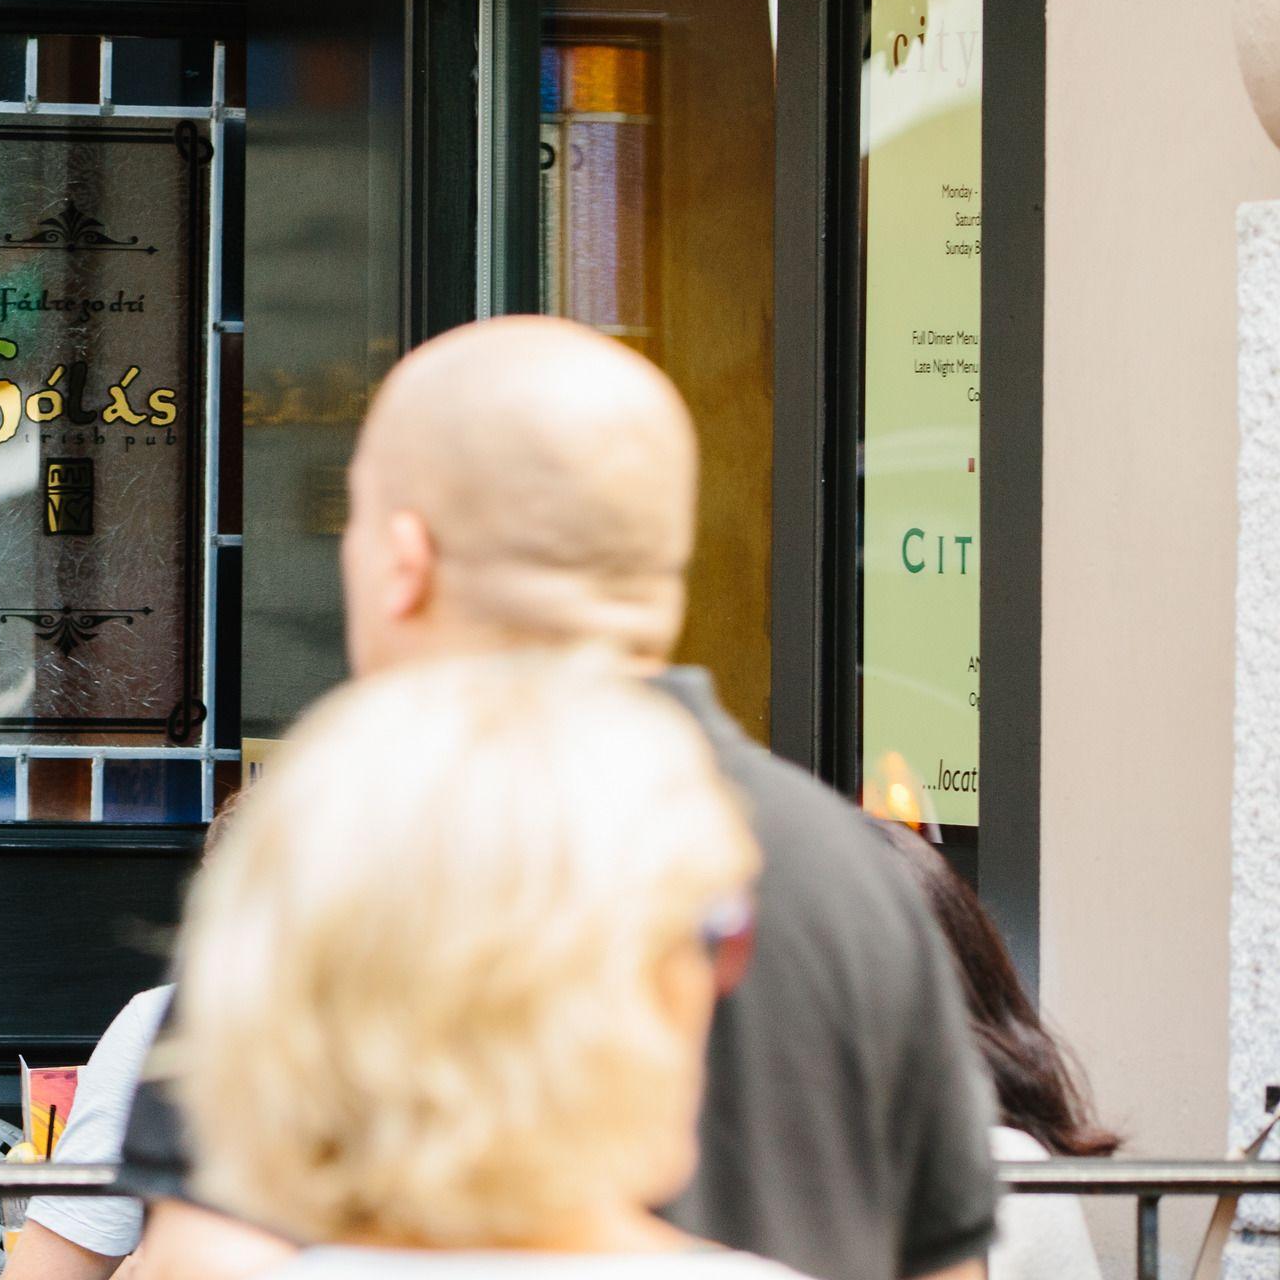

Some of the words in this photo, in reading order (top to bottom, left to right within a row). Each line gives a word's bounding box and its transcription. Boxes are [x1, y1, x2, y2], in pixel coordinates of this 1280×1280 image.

[942, 184, 973, 203] Monday
[945, 240, 972, 260] Sunday
[912, 330, 926, 346] Full
[928, 330, 954, 346] Dinner
[957, 330, 979, 346] Menu
[914, 359, 931, 374] Late
[933, 359, 955, 378] Night
[957, 359, 979, 374] Menu
[123, 426, 178, 452] pub
